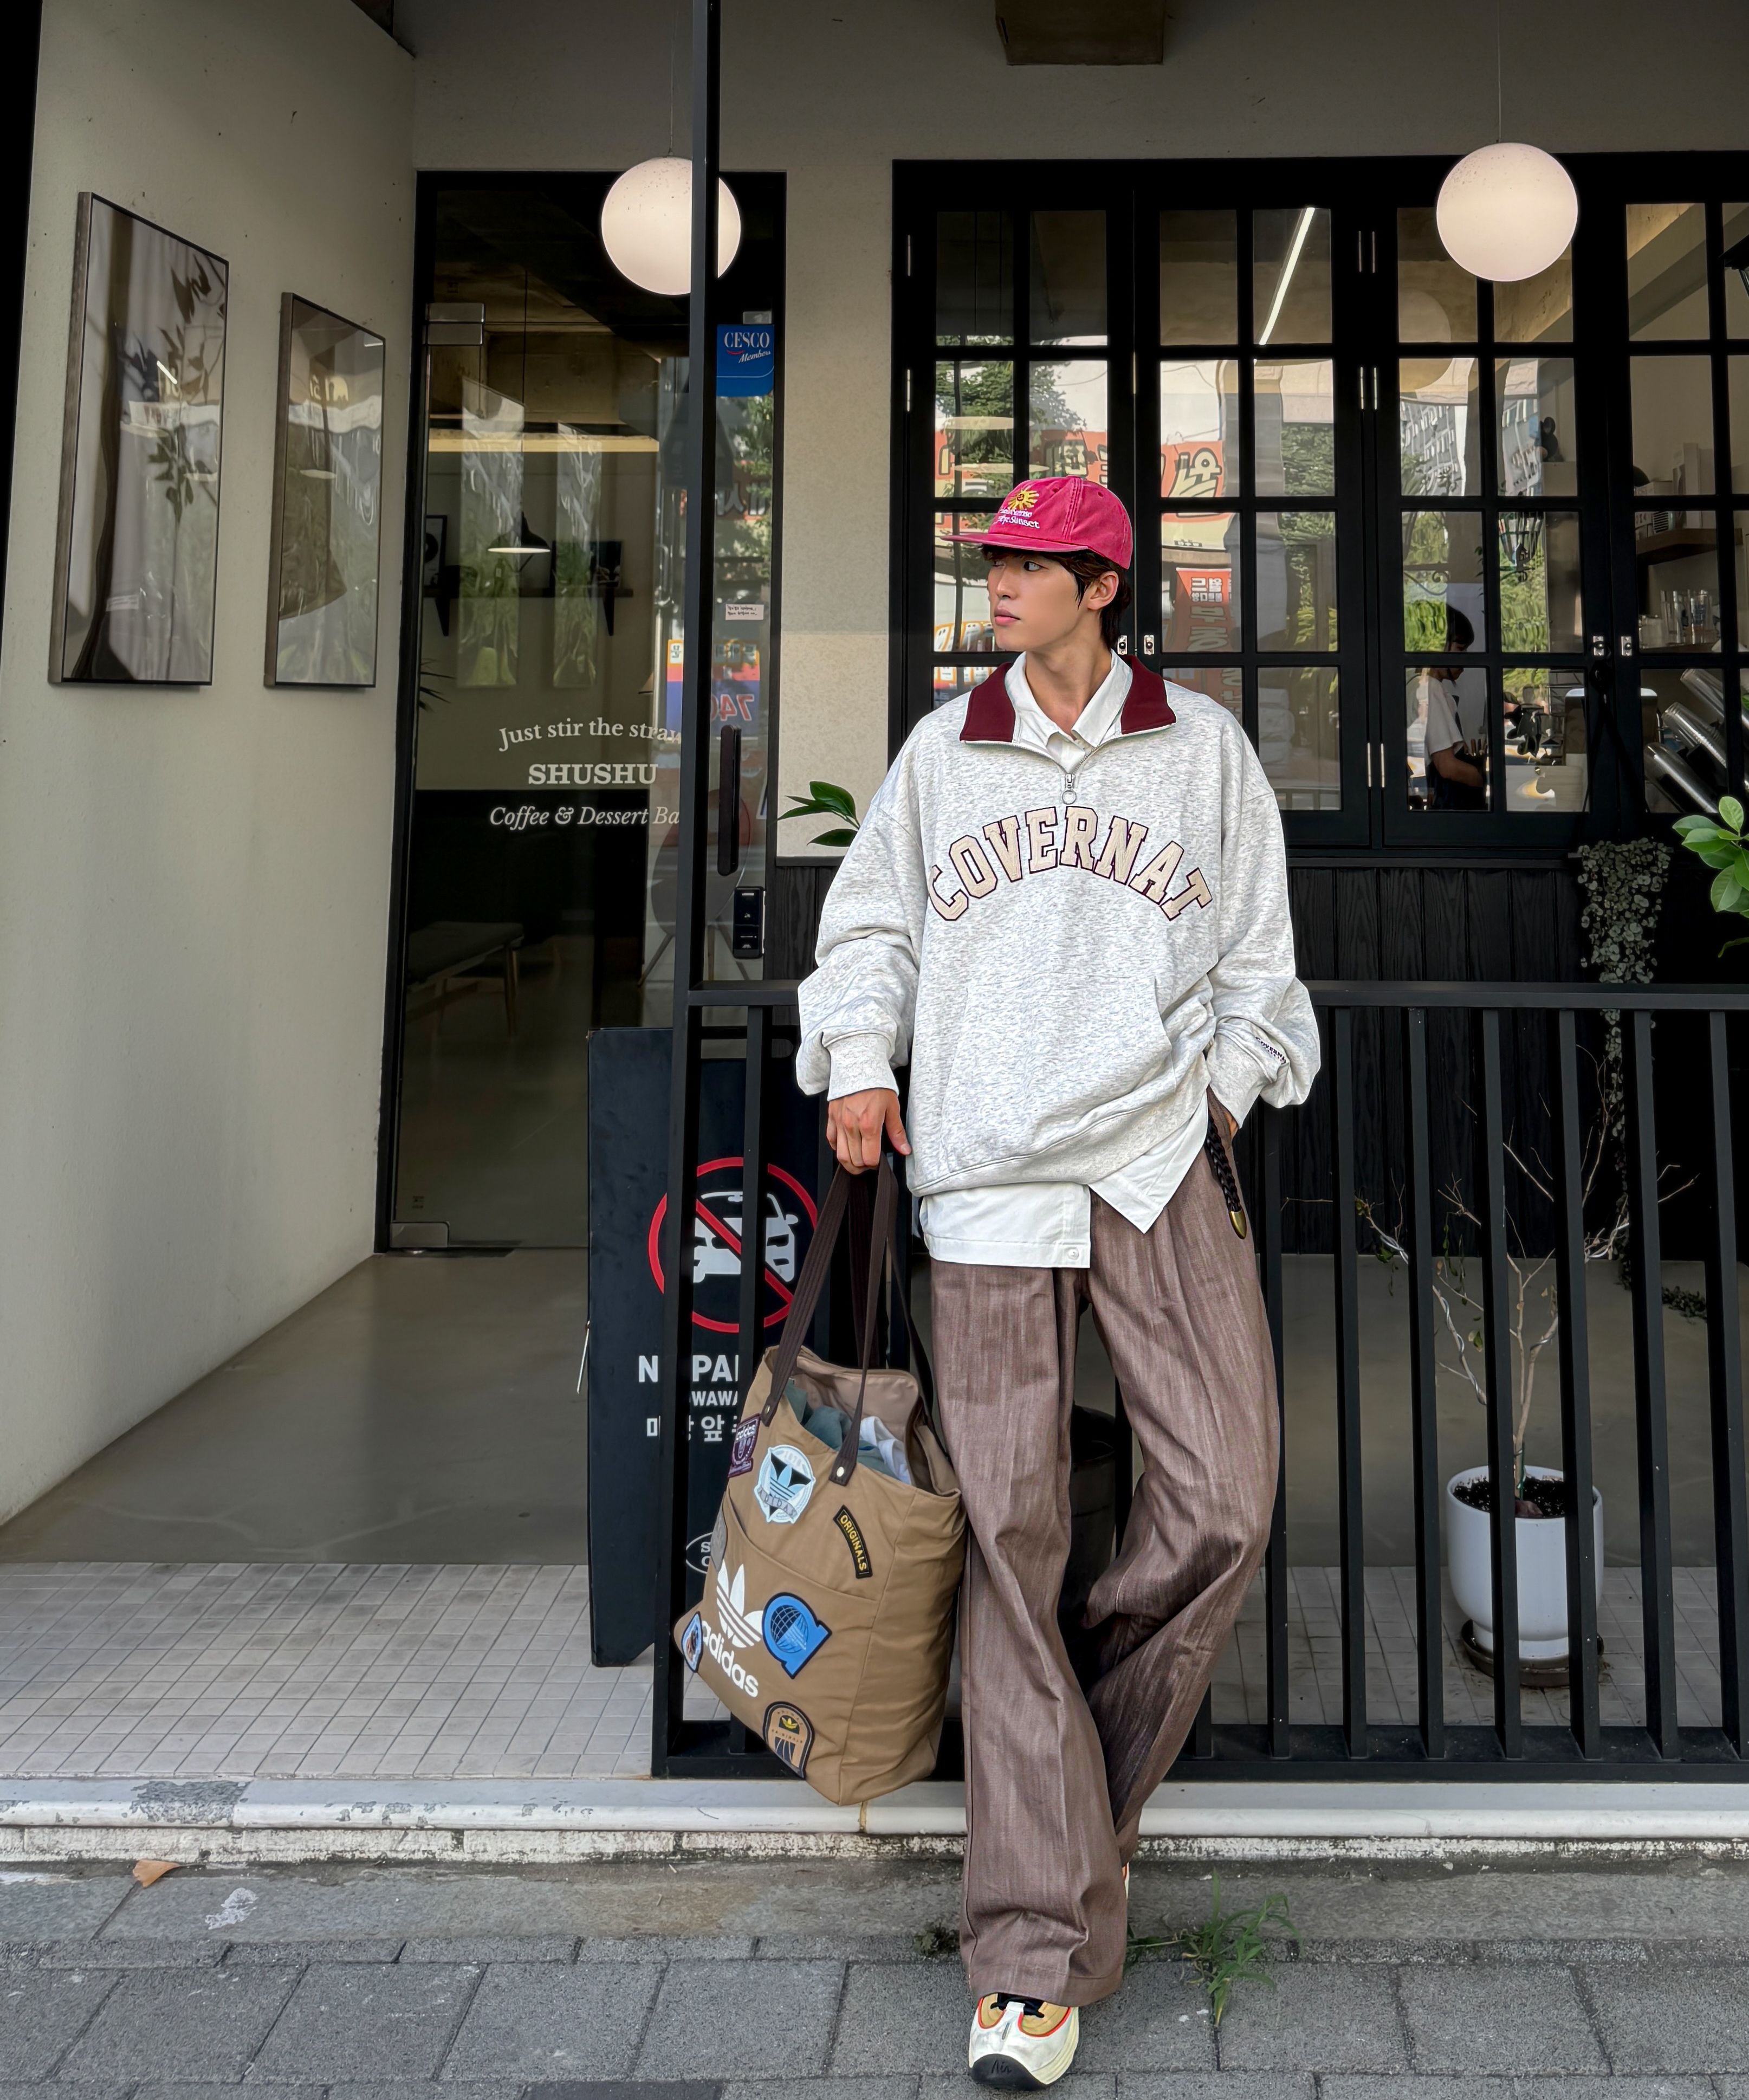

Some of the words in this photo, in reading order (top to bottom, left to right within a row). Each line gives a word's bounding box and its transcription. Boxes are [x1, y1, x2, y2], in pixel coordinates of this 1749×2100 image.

[724, 332, 770, 348] CESCO
[738, 349, 771, 364] Members
[498, 723, 542, 752] Just
[547, 718, 584, 738] stir
[589, 716, 624, 736] the
[528, 763, 658, 785] SHUSHU
[490, 805, 550, 831] Coffee
[554, 806, 574, 825] &
[577, 806, 649, 825] Dessert
[653, 806, 680, 825] Ba
[929, 805, 1214, 922] COVERNAT
[638, 1355, 659, 1383] N
[692, 1354, 739, 1382] PA
[701, 1414, 725, 1442] 앞
[840, 1514, 867, 1572] ORIGINALS
[702, 1620, 759, 1698] adidas
[991, 2059, 1012, 2074] Air
